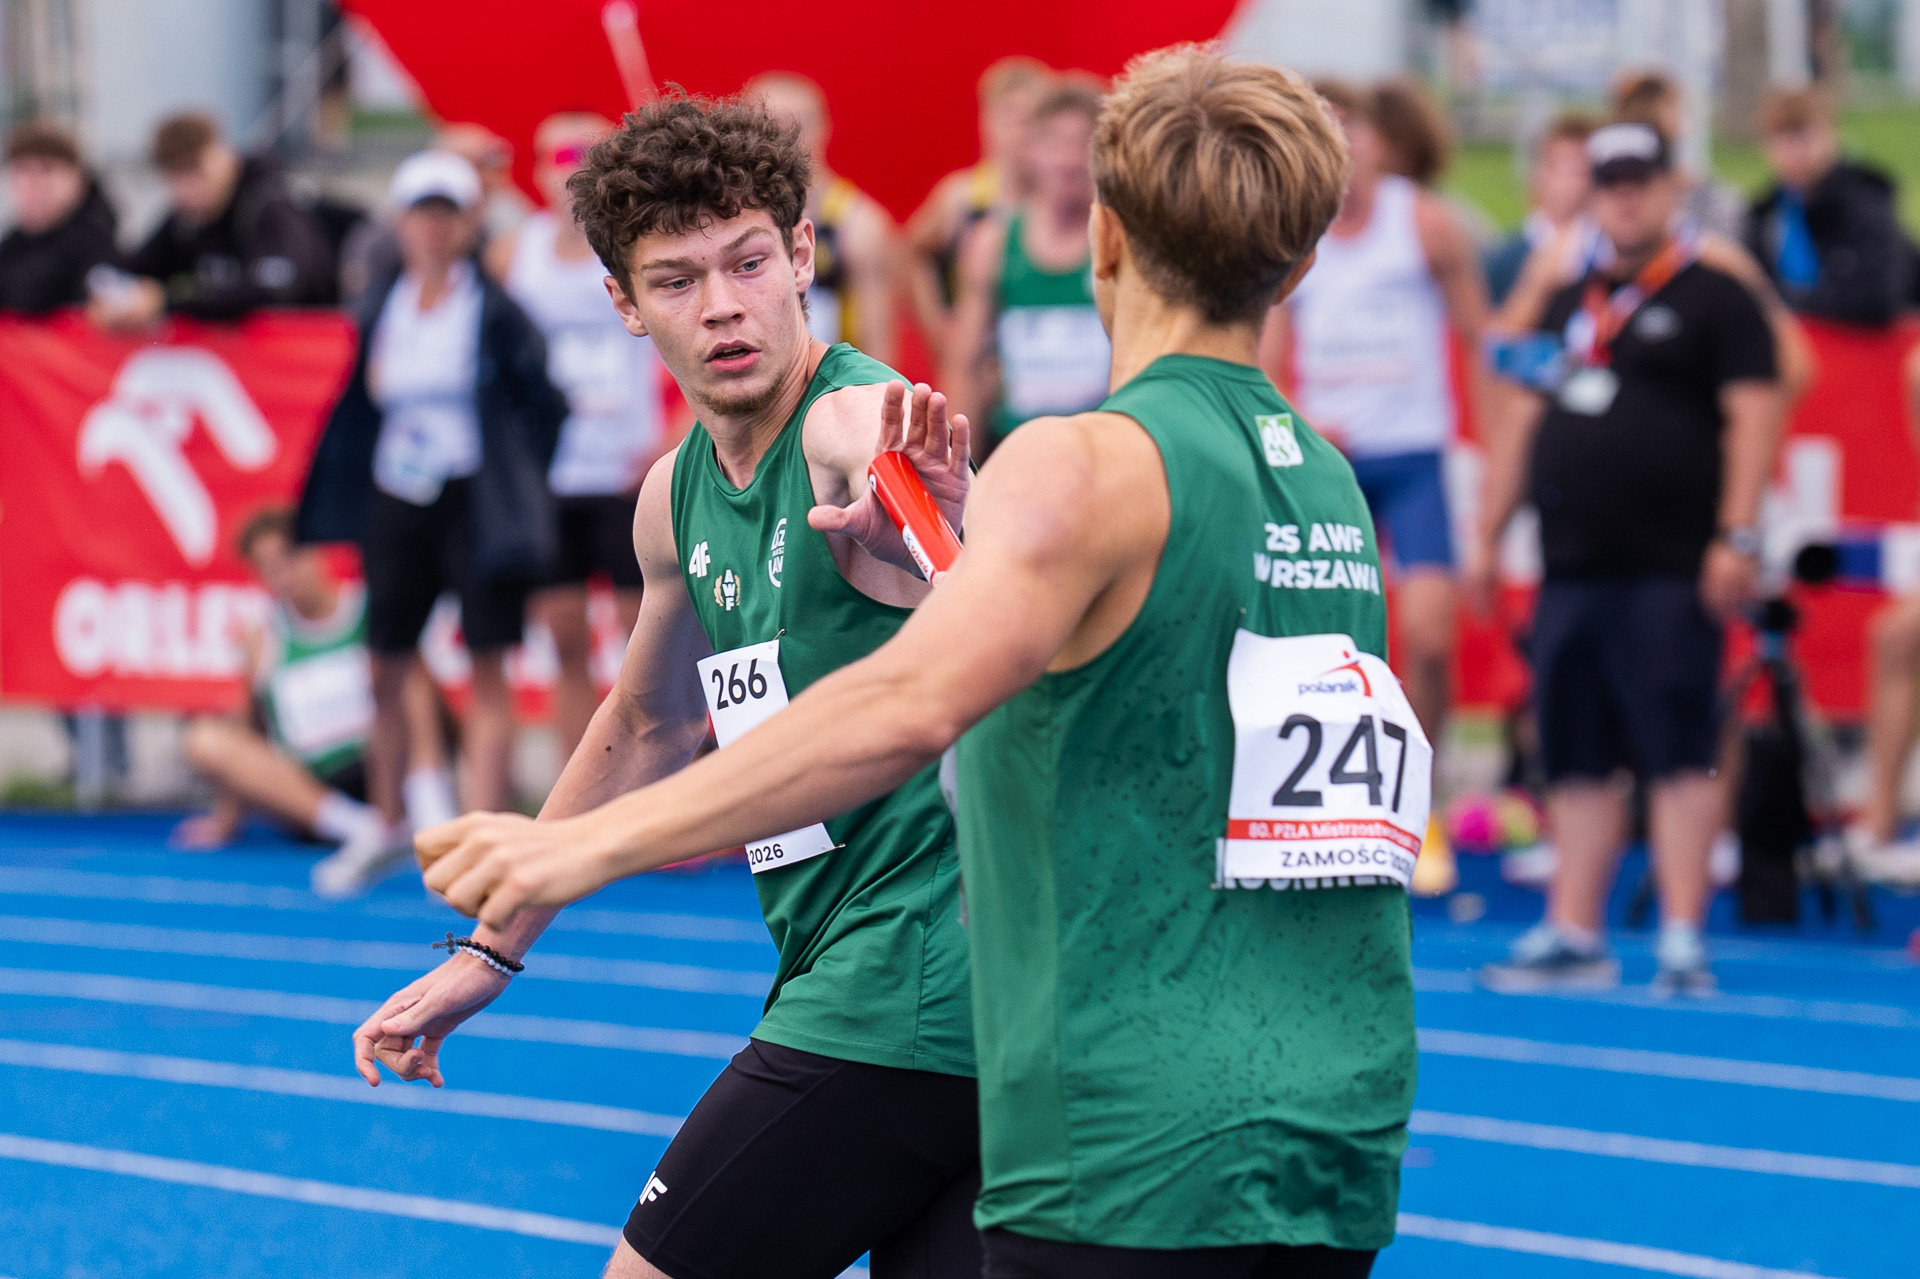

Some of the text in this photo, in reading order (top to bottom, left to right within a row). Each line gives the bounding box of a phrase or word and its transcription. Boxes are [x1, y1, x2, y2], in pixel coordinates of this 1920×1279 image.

[1308, 522, 1364, 554] AWF
[688, 541, 711, 578] 4F
[712, 658, 767, 710] 266
[1298, 680, 1357, 695] polanik
[1272, 714, 1406, 813] 247
[1273, 822, 1311, 839] PZLA
[749, 843, 784, 865] 2026
[1280, 843, 1388, 868] ZAMOŚĆ
